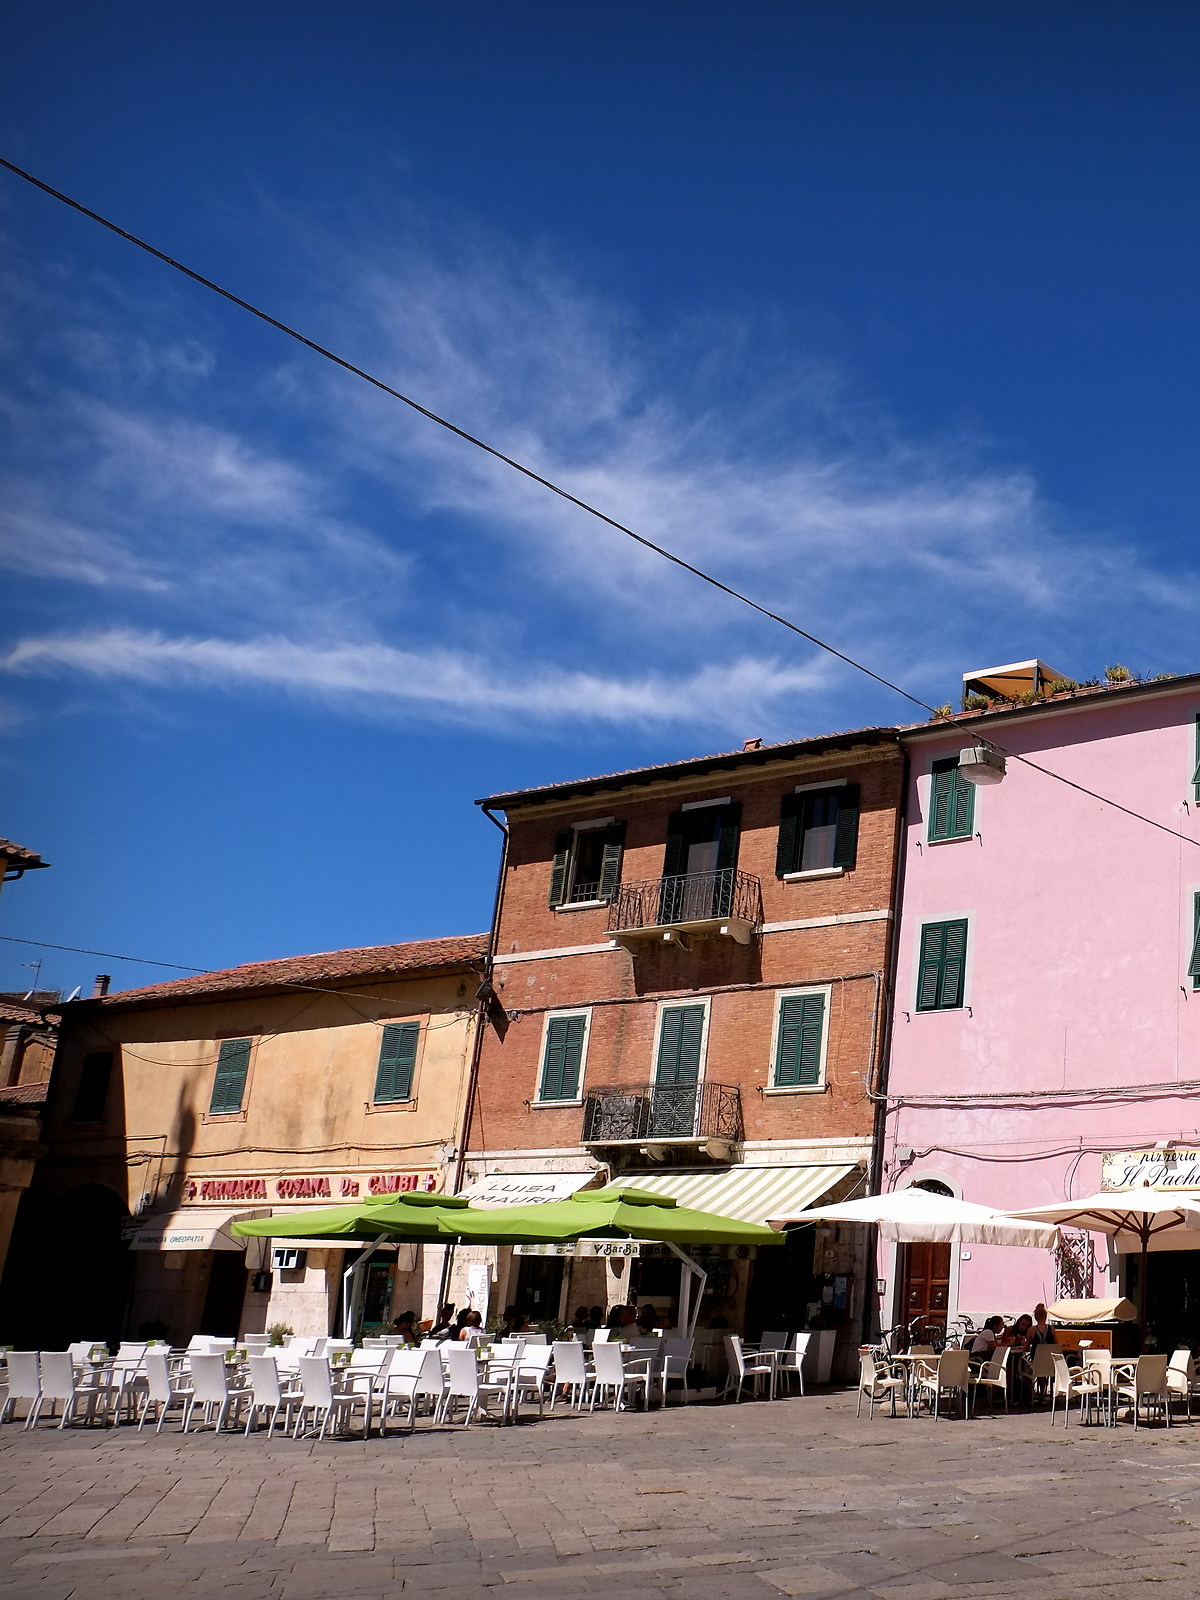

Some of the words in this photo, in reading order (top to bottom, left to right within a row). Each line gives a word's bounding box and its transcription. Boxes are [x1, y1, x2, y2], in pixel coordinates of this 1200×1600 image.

[1139, 1150, 1197, 1165] pizzeria
[1113, 1164, 1146, 1188] Il
[200, 1179, 268, 1198] FARMACIA
[368, 1174, 419, 1193] CAMBI
[488, 1184, 556, 1193] LUISA
